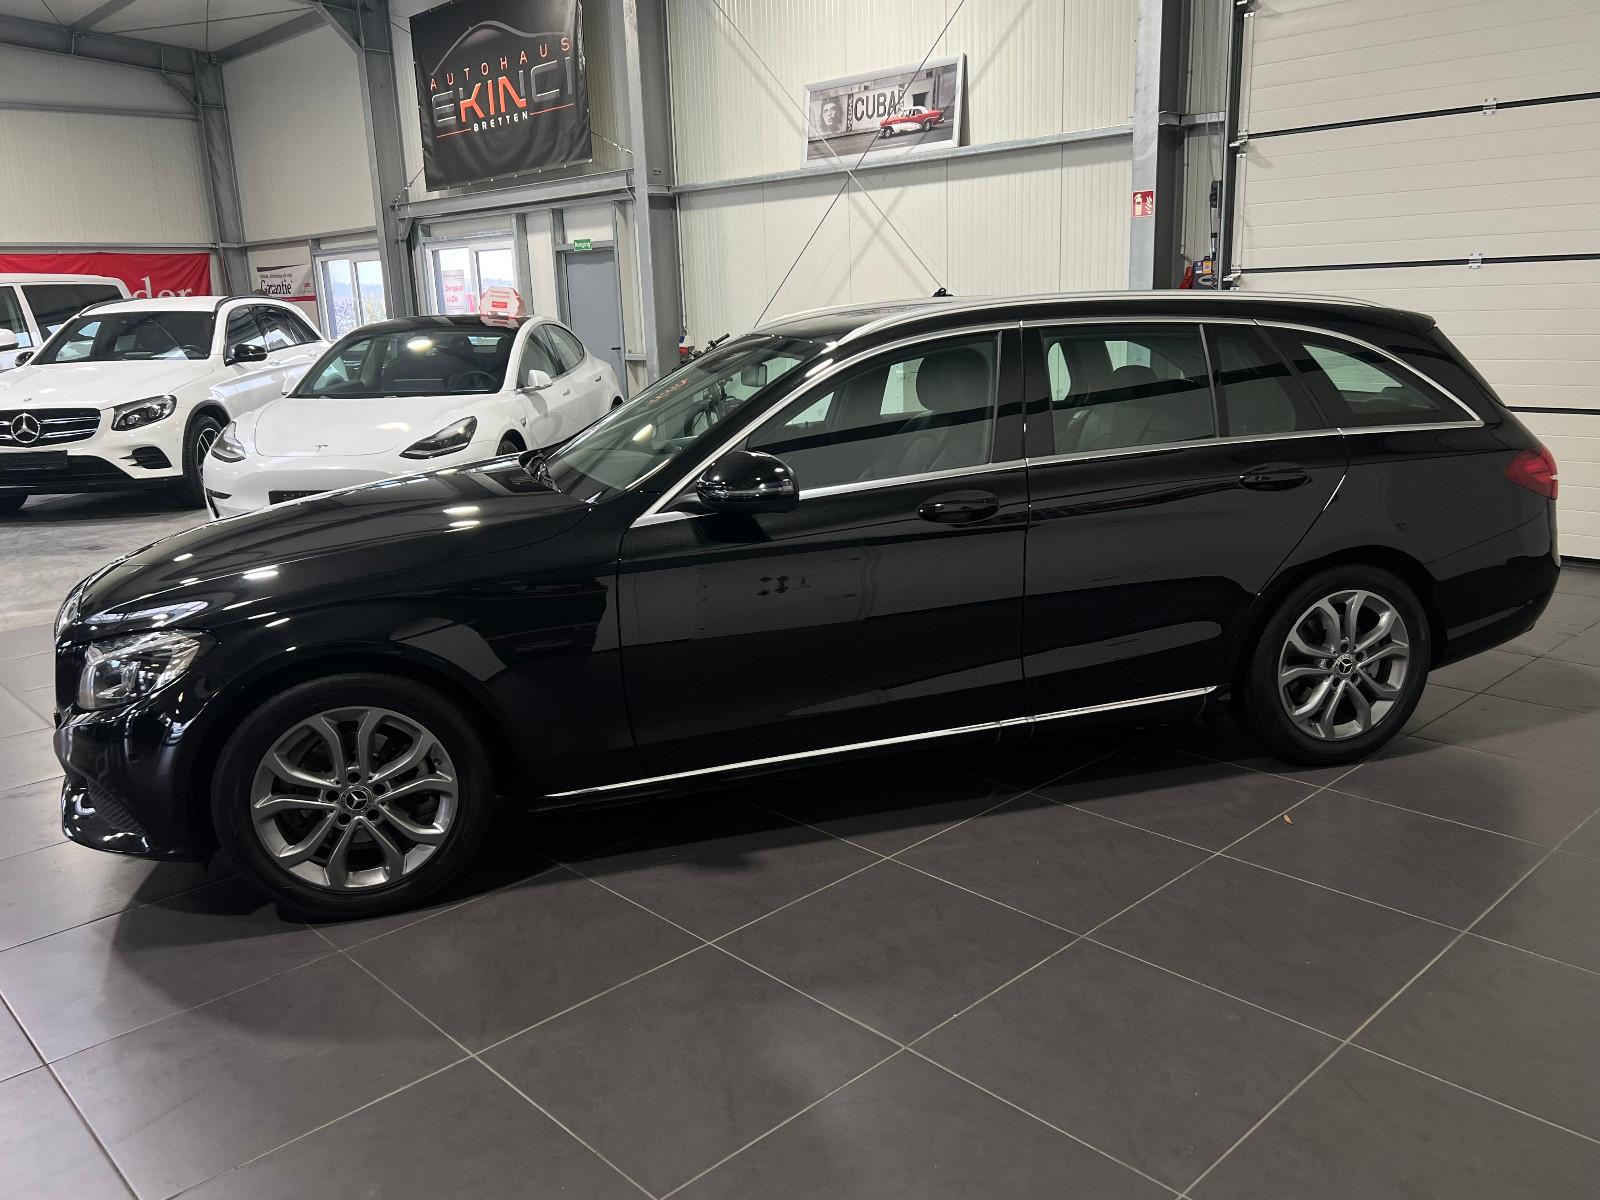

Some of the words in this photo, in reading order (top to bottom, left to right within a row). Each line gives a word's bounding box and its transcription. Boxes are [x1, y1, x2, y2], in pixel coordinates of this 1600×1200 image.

[430, 37, 570, 91] AUTOHAUS
[473, 110, 528, 132] BRETTEN
[854, 91, 897, 121] CUBA
